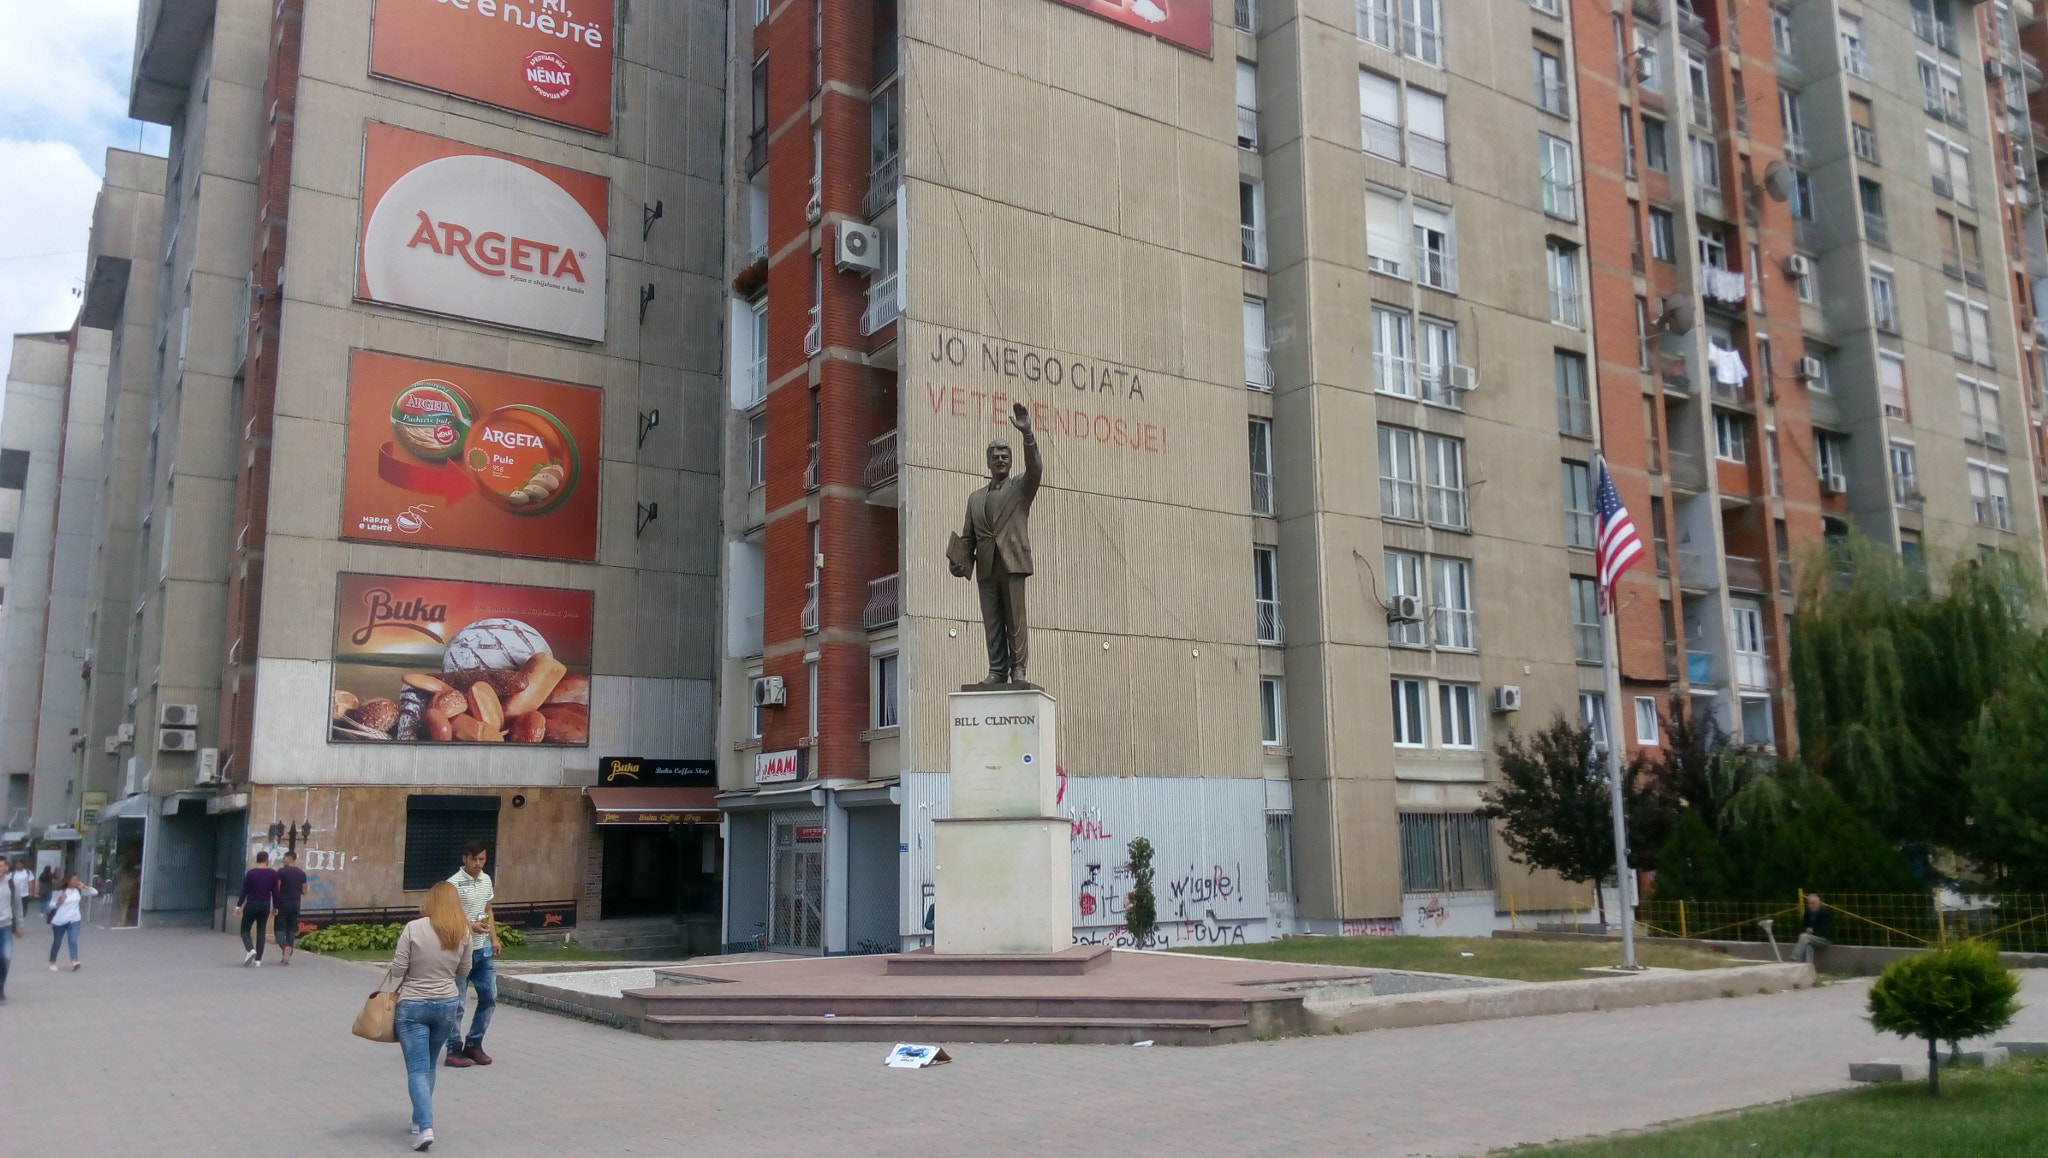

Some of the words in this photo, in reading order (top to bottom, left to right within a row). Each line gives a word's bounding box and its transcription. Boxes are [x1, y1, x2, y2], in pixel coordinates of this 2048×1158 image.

[526, 66, 572, 86] NËNAT
[931, 334, 966, 366] JO
[482, 426, 544, 449] ARGETA
[493, 454, 514, 465] Pule
[352, 589, 446, 645] Buka
[954, 717, 979, 726] BILL
[985, 715, 1036, 726] CLINTON
[607, 760, 640, 782] Buka
[674, 767, 693, 776] Coffee
[694, 767, 710, 776] Shop
